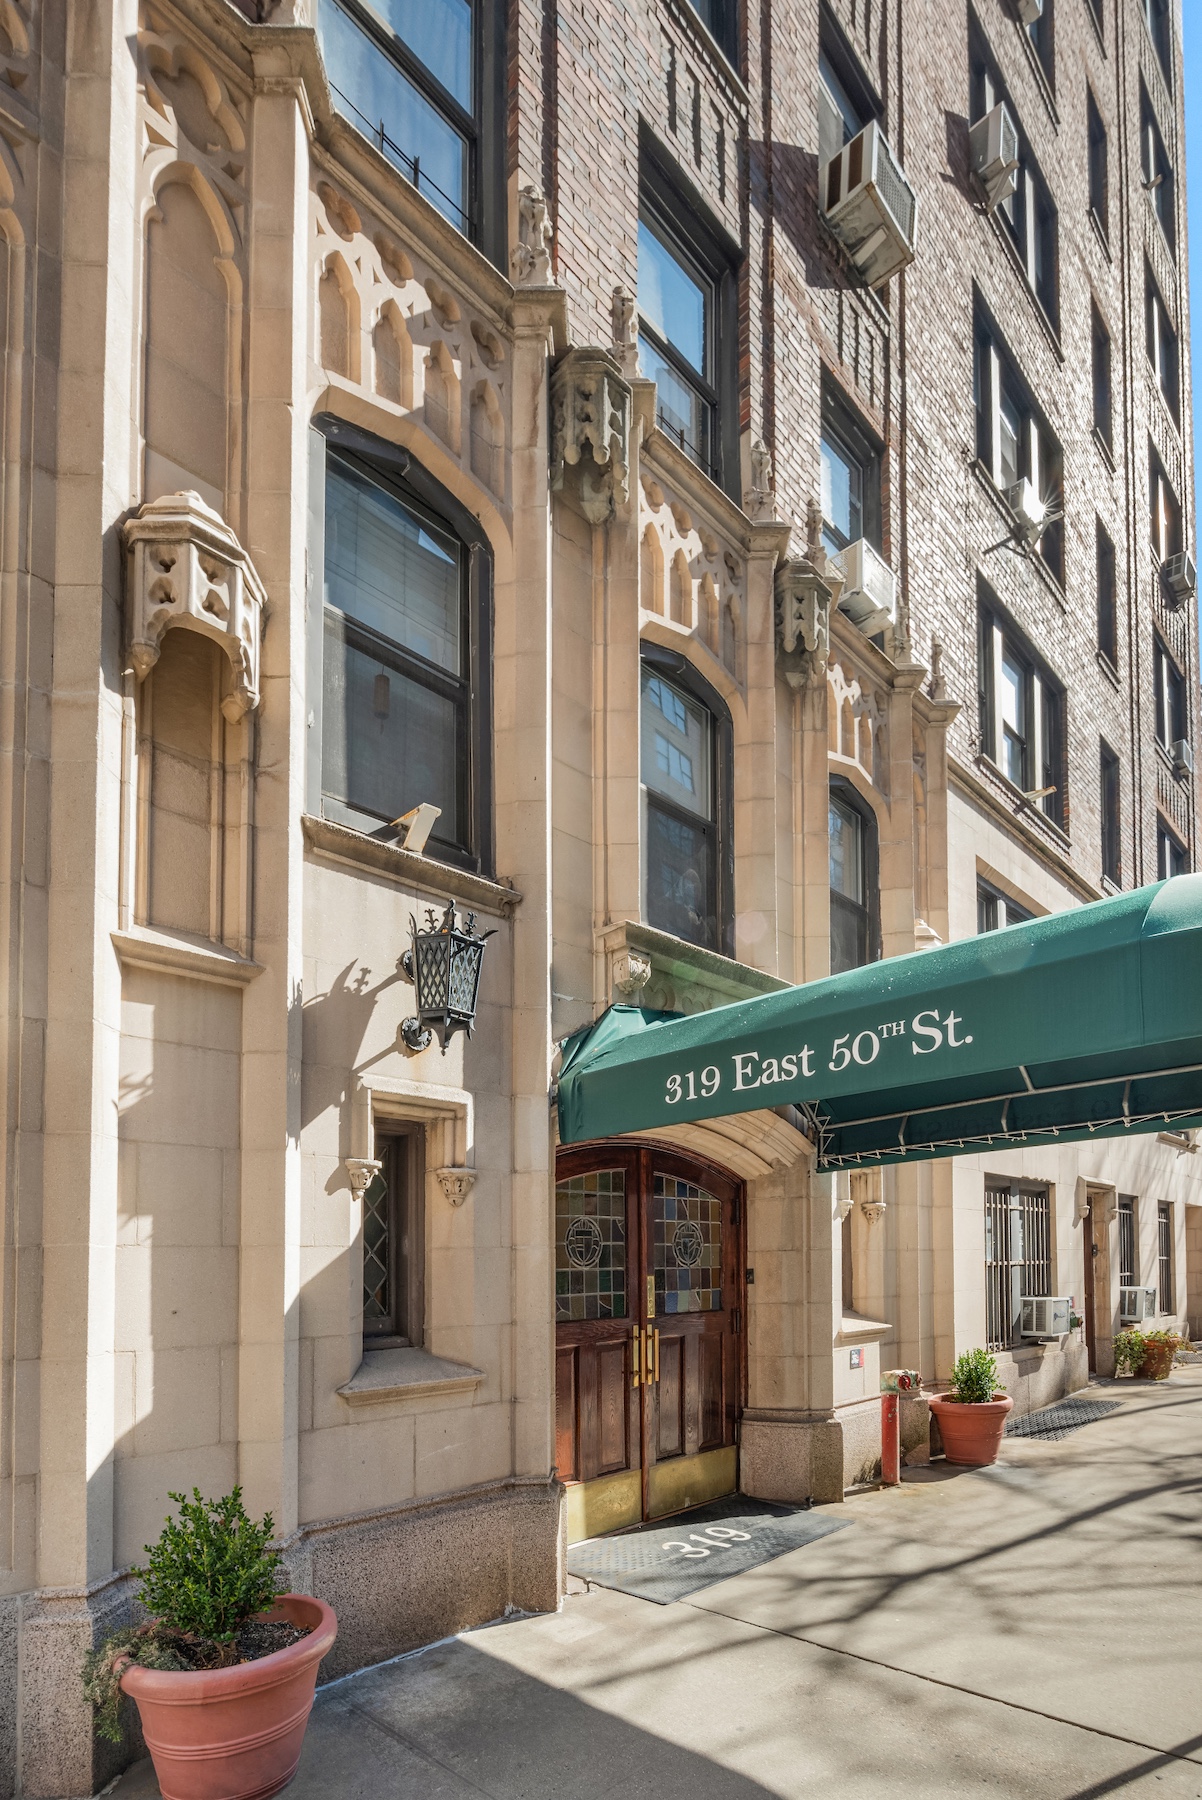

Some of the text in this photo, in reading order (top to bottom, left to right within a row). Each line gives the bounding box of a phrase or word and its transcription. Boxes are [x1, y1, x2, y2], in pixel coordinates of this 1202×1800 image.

[664, 1066, 721, 1104] 319
[731, 1044, 816, 1091] East
[911, 1008, 974, 1055] St.
[661, 1527, 752, 1558] 319
